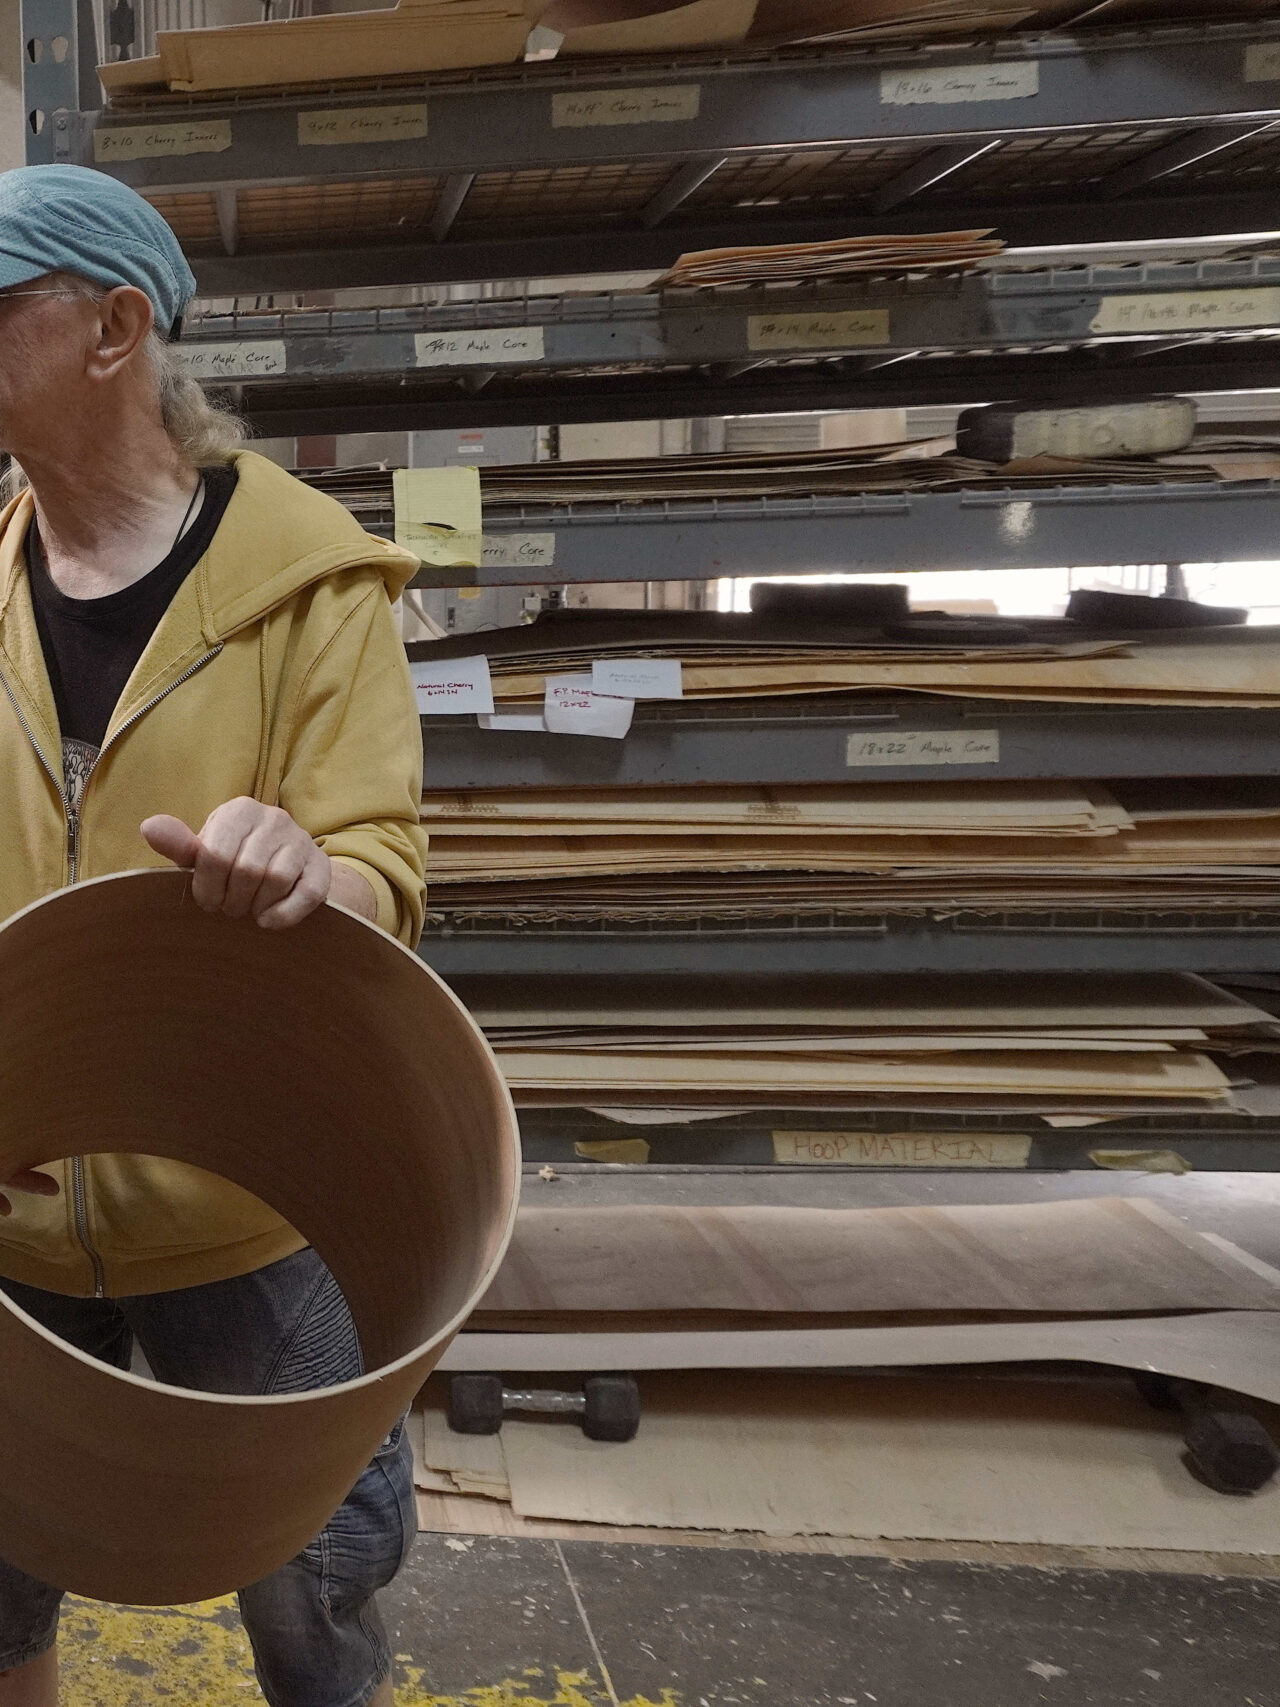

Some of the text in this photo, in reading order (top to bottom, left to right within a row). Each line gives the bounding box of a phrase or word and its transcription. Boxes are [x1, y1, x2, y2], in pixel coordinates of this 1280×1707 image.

[144, 134, 176, 148] Cherry
[502, 339, 529, 350] Core
[245, 351, 271, 363] Core
[519, 541, 545, 556] Core
[447, 682, 474, 692] Cherry
[858, 1135, 996, 1164] MATERIAL
